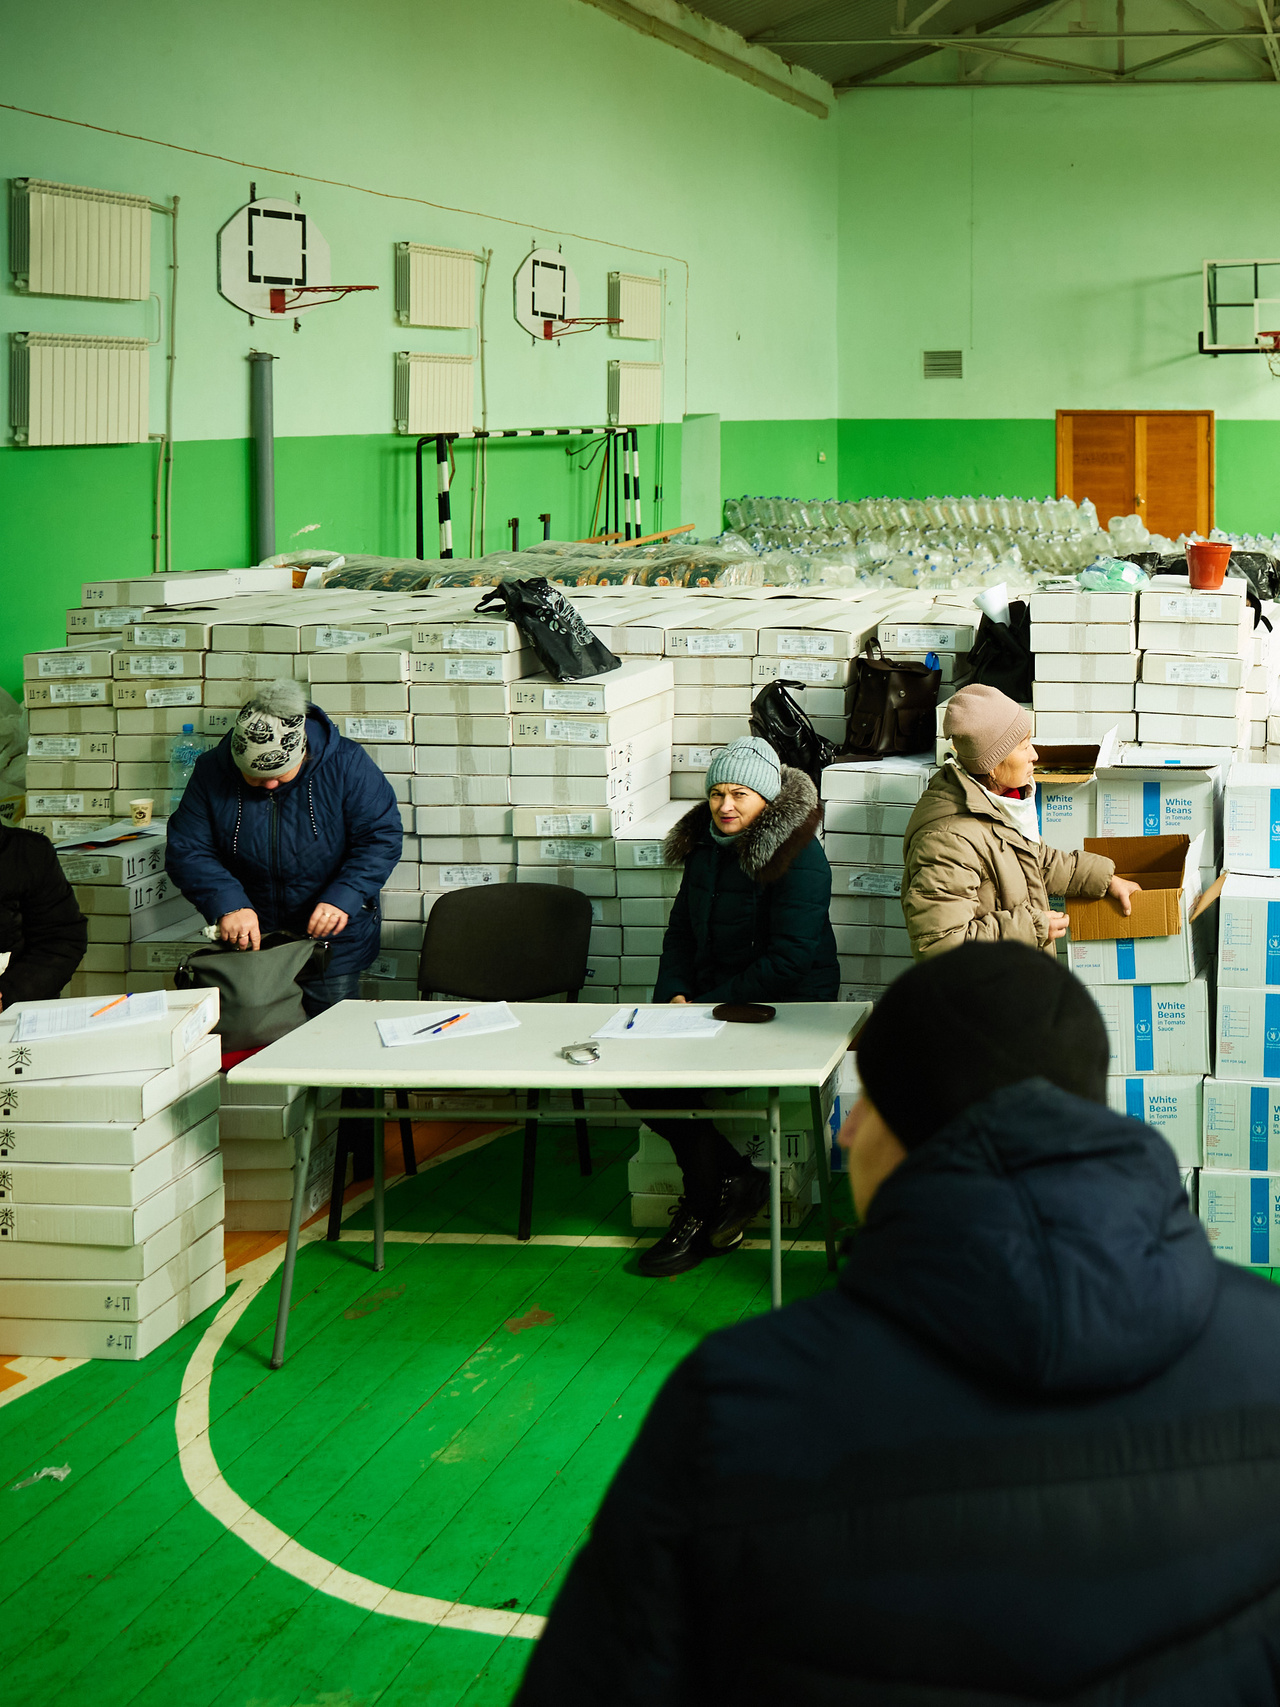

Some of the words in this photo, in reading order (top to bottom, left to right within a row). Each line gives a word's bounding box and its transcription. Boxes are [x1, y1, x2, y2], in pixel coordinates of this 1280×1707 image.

[1046, 795, 1073, 803] White
[1165, 798, 1192, 806] White
[1046, 803, 1072, 811] Beans
[1166, 806, 1192, 814] Beans
[1157, 1002, 1186, 1010] White
[1149, 1096, 1177, 1104] White
[1150, 1105, 1177, 1113] Beans
